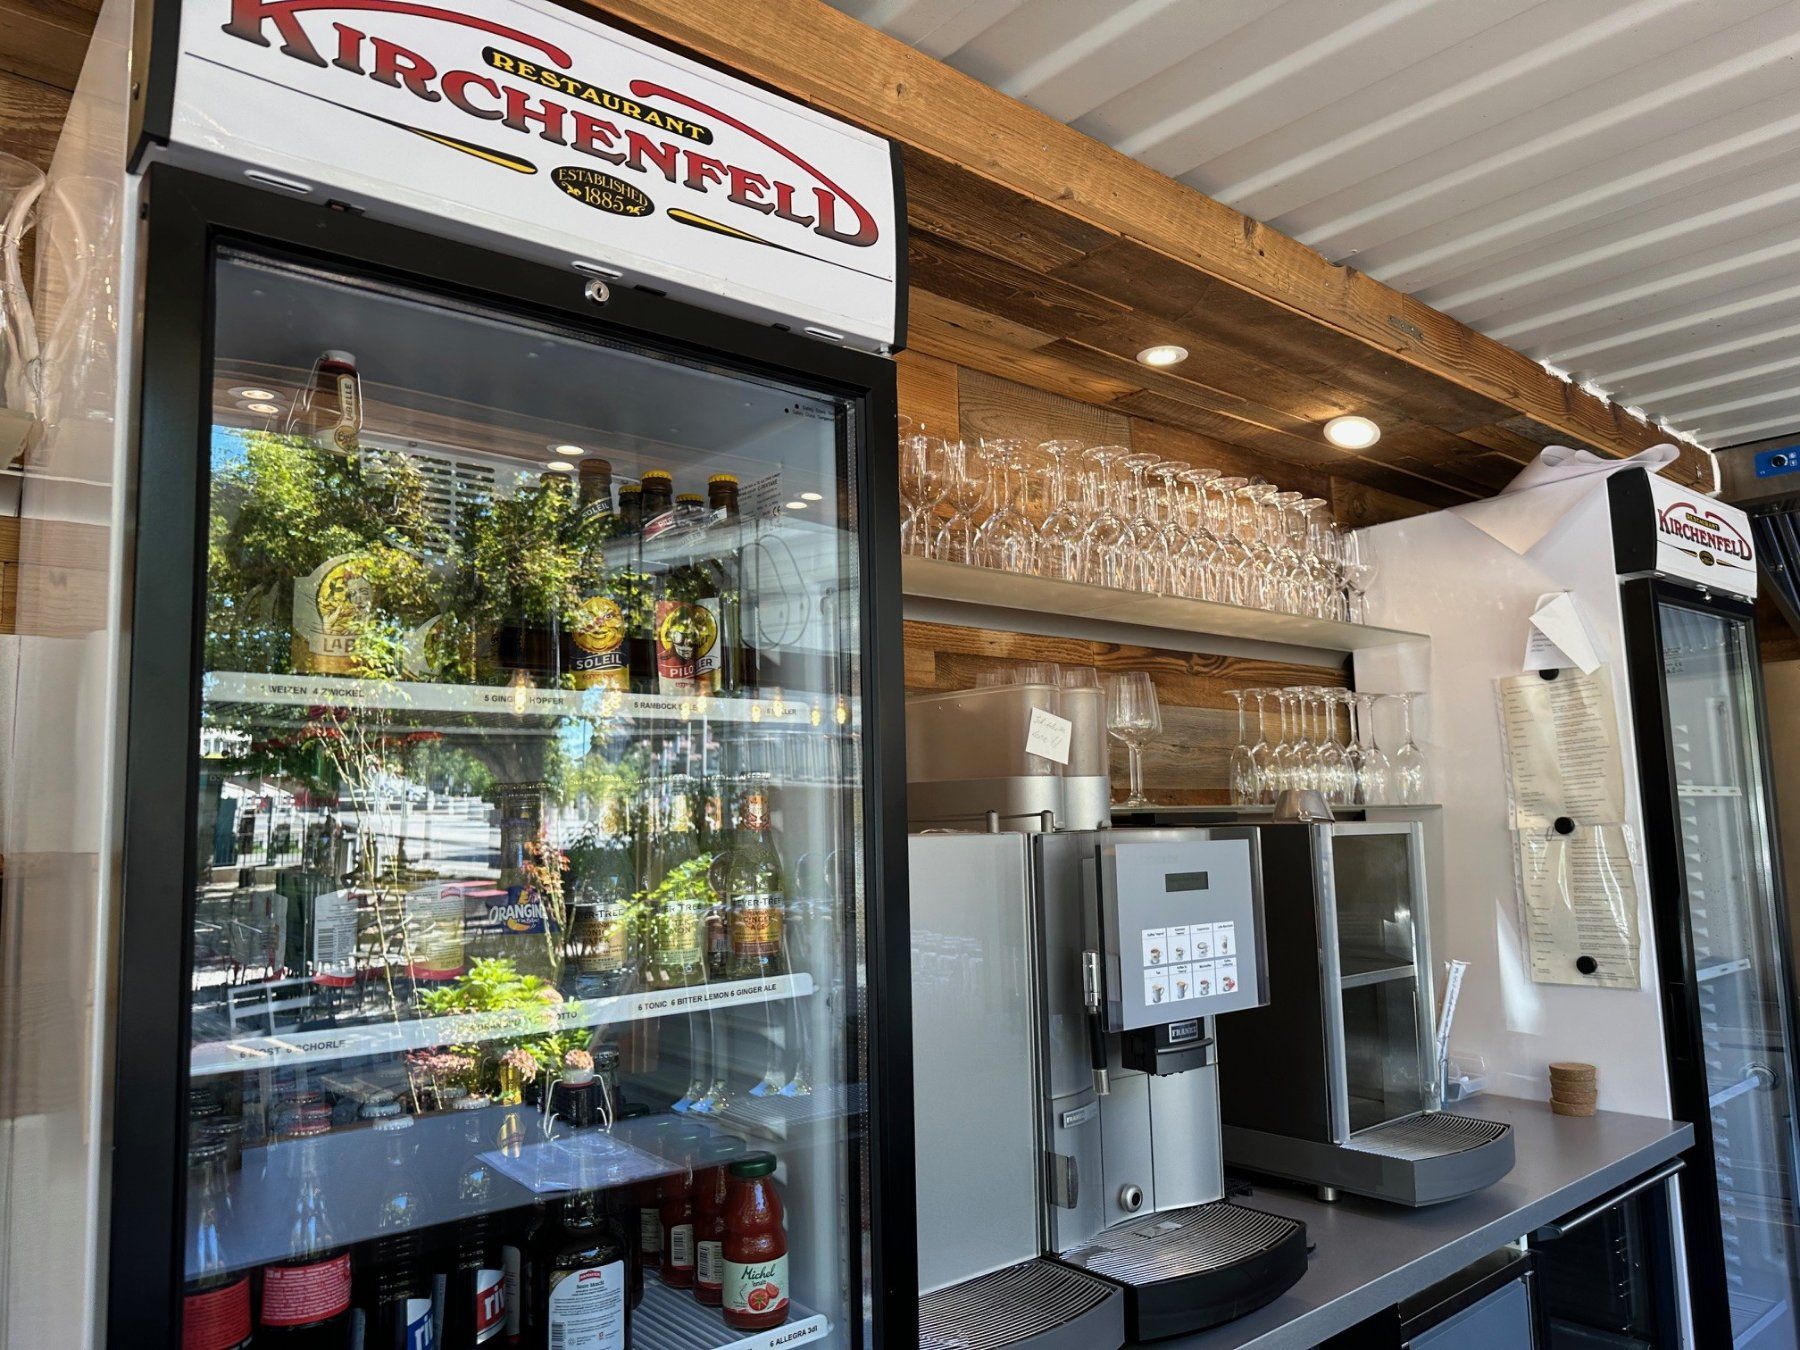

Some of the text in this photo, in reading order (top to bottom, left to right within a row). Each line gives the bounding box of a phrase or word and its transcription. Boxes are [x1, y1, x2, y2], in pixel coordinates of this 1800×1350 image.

[492, 50, 708, 142] RESTAURANT
[221, 0, 877, 248] KIRCHENFELD
[559, 168, 648, 207] ESTABLISHED
[584, 186, 624, 212] 1885
[582, 502, 610, 519] SOLEIL
[1657, 502, 1752, 561] KIRCHENFELD
[576, 654, 622, 670] SOLEIL
[269, 685, 307, 695] WEIZEN
[634, 701, 639, 709] 5
[640, 702, 677, 710] RAMBOCK
[488, 902, 546, 923] ORANGIN
[638, 1003, 643, 1011] 6
[645, 1000, 668, 1010] TONIC
[677, 996, 703, 1006] BITTER
[704, 991, 730, 1001] LEMON
[736, 986, 763, 997] GINGER
[763, 983, 777, 992] ALE
[249, 1046, 281, 1058] OST
[741, 1264, 777, 1280] Michel
[776, 1330, 807, 1346] ALLEGRA
